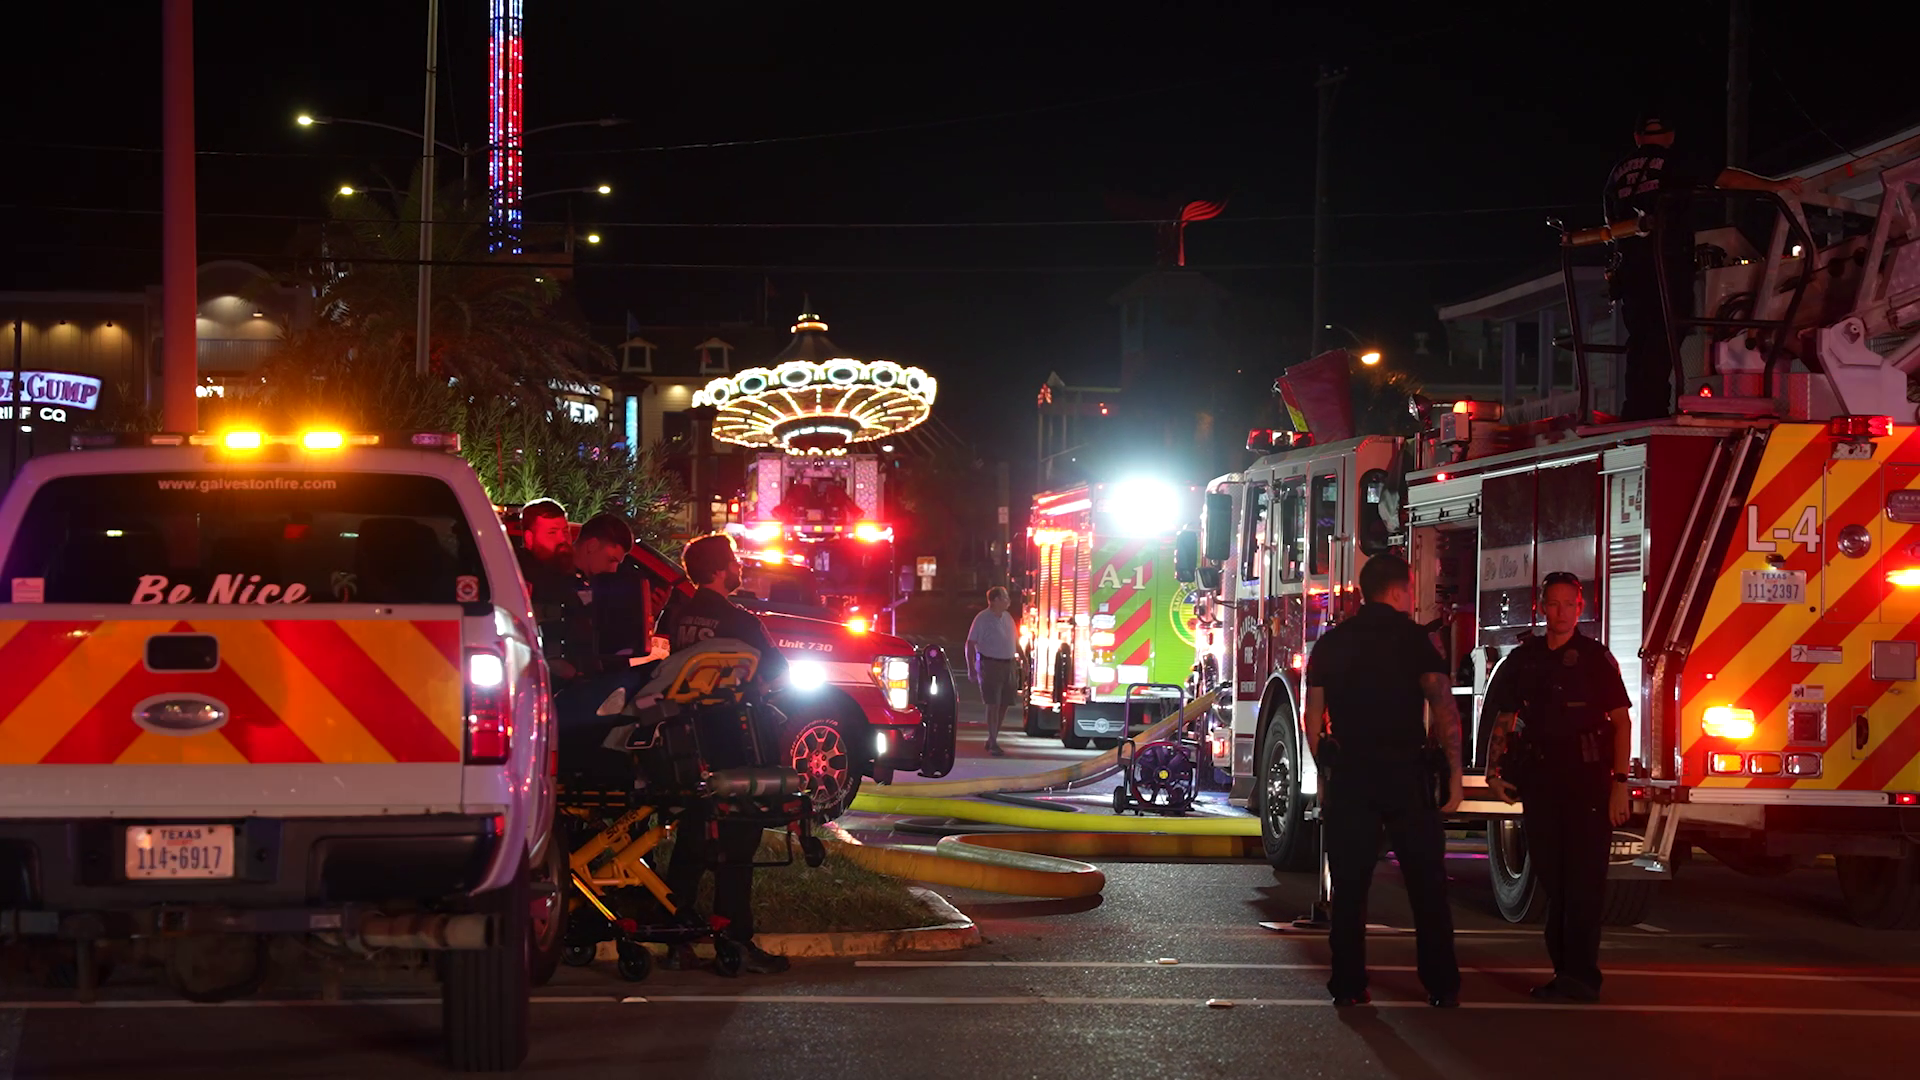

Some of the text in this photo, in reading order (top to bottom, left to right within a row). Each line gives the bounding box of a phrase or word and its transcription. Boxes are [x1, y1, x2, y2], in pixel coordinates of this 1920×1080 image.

[27, 374, 97, 404] GUMP
[158, 477, 337, 493] www.galvestonfire.com
[1747, 504, 1821, 554] L-4
[1098, 563, 1146, 591] A-1
[1761, 572, 1787, 580] TEXAS
[131, 573, 310, 605] Be Nice
[778, 638, 834, 653] Unit 730
[160, 829, 202, 840] TEXAS
